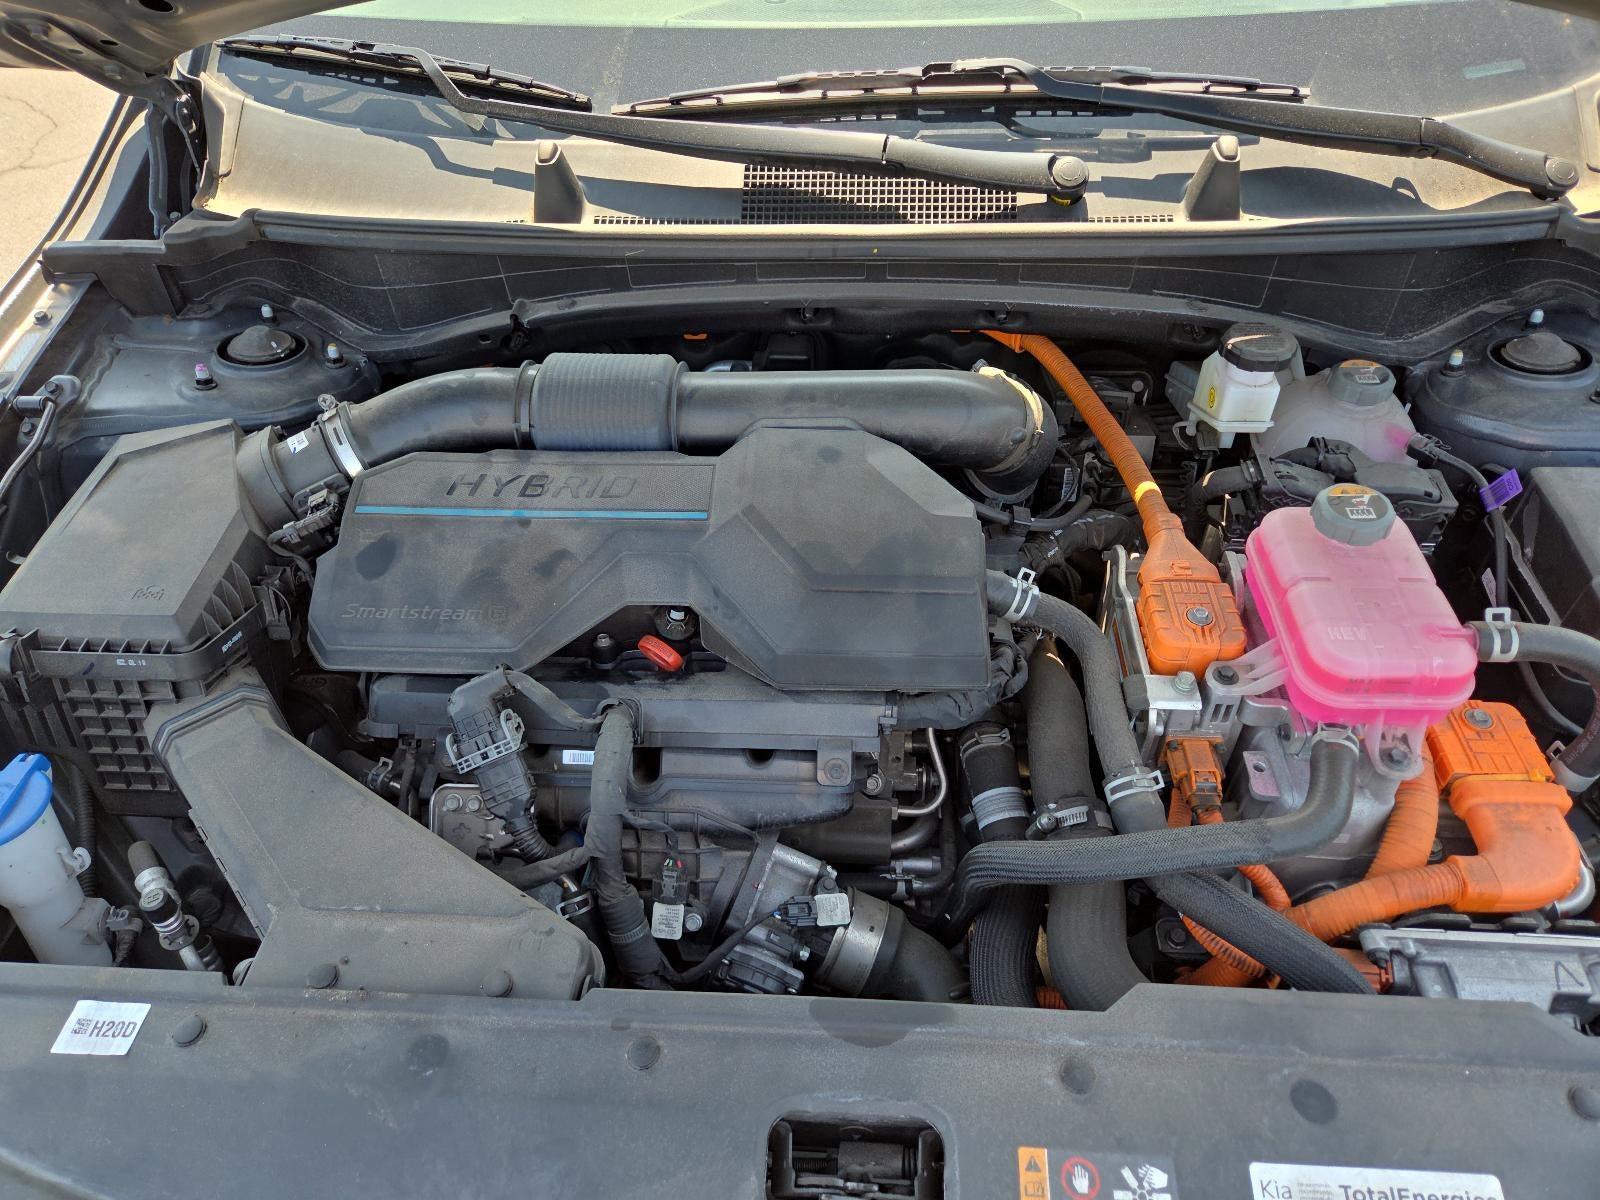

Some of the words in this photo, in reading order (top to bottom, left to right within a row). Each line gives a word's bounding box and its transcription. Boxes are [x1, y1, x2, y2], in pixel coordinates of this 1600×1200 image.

[446, 473, 637, 498] HYBRID
[342, 603, 482, 620] Smartstream
[1260, 1180, 1292, 1199] Kia
